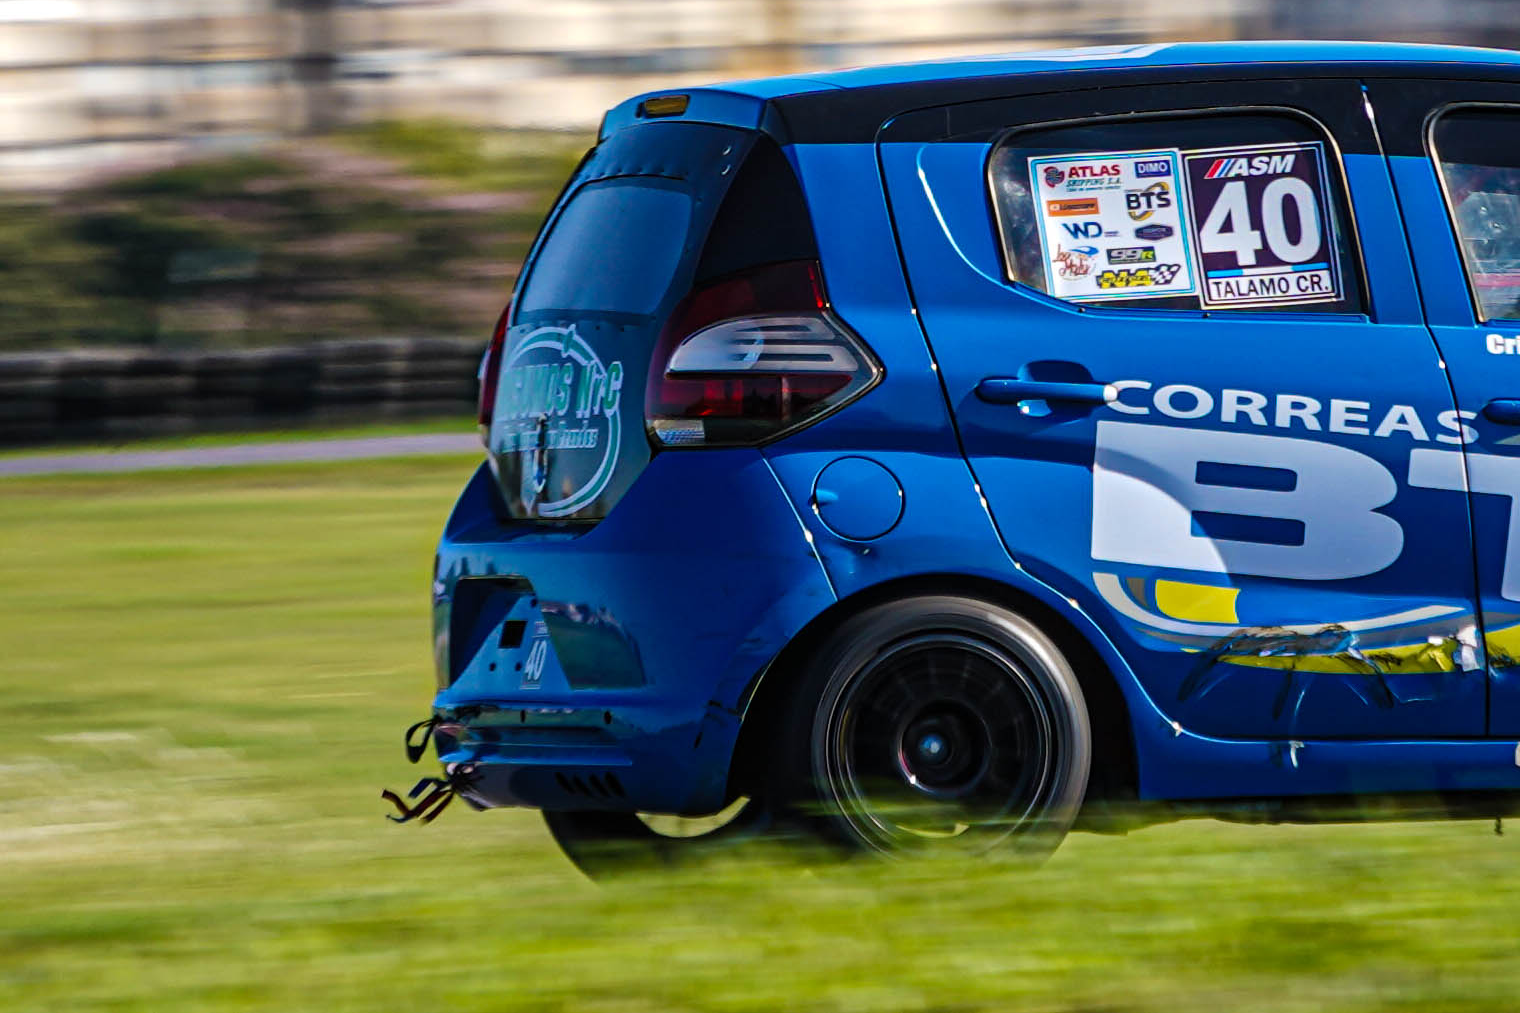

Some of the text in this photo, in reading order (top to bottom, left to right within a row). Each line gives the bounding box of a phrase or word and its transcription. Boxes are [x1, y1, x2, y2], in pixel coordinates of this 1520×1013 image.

[1068, 164, 1121, 178] ATLAS
[1137, 161, 1168, 174] DIMO
[1126, 191, 1171, 210] BTS
[1200, 177, 1322, 266] 40
[1213, 275, 1329, 299] TALAMO CR.
[1105, 380, 1479, 444] CORREAS
